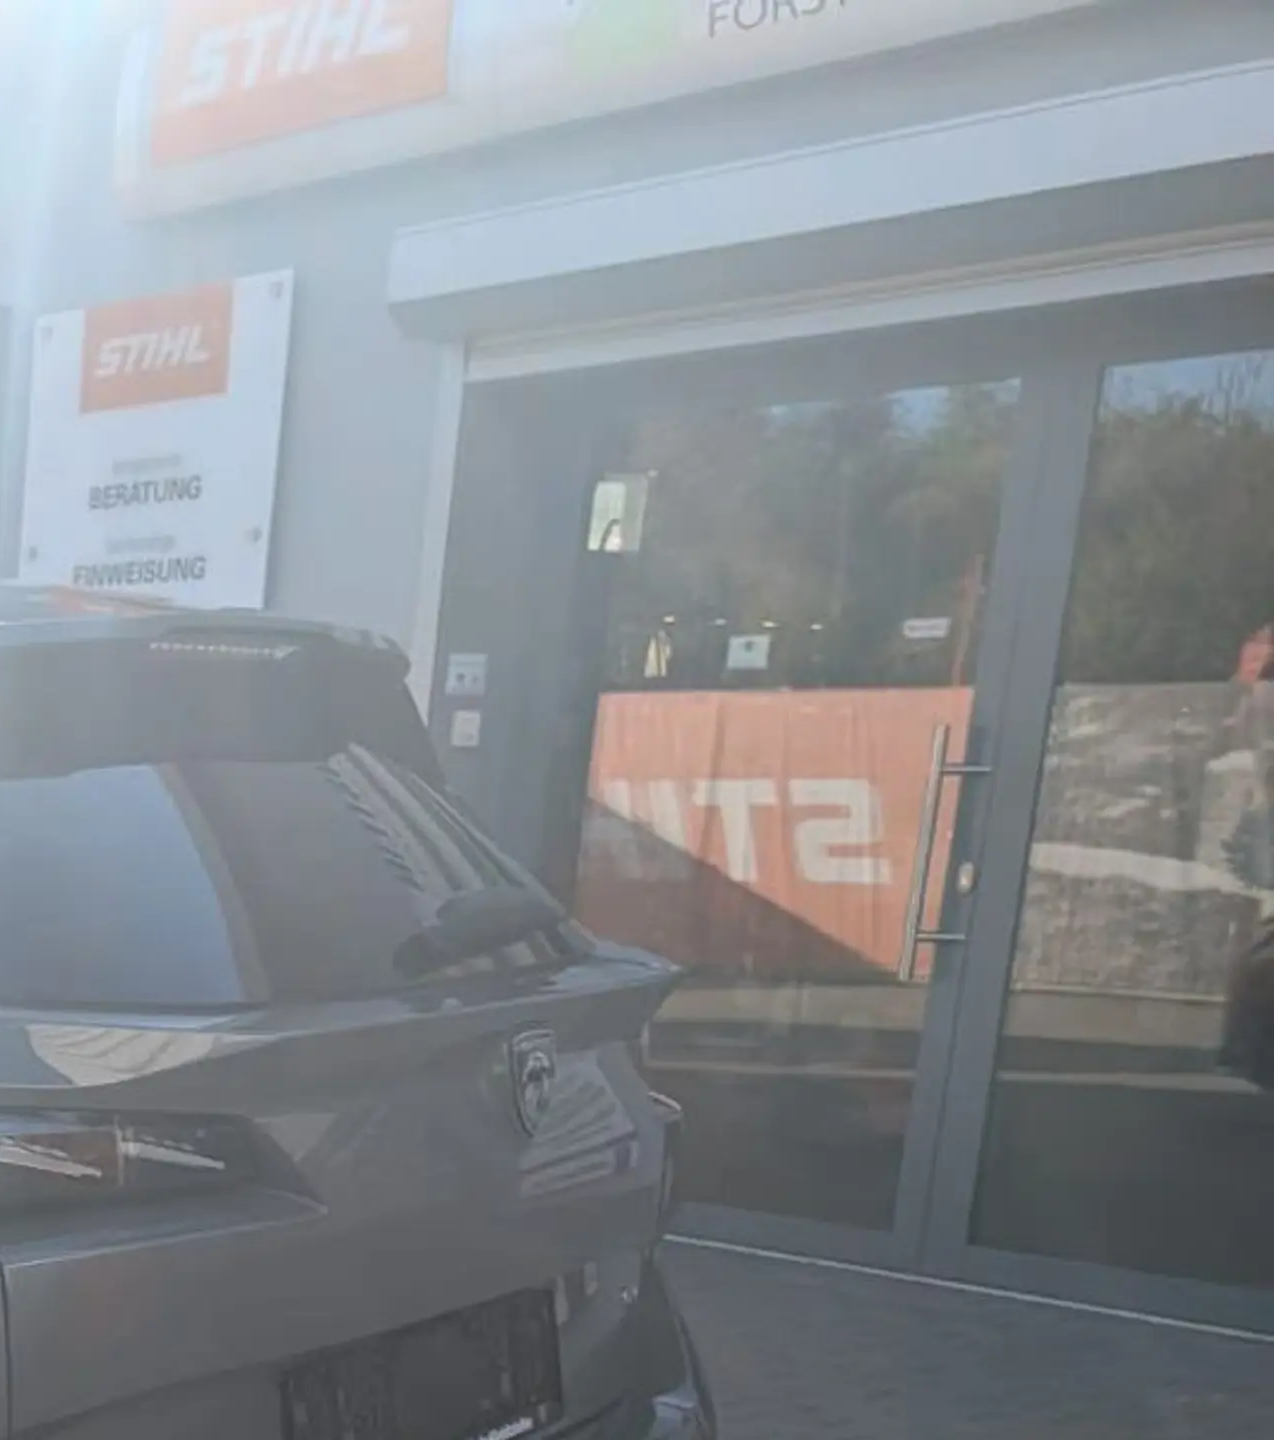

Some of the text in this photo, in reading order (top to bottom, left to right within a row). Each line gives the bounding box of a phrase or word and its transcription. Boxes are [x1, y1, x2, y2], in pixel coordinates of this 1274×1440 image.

[707, 0, 847, 39] FOR
[181, 0, 412, 107] STIHL
[94, 325, 210, 378] STIHL
[88, 474, 204, 511] BERATUNG
